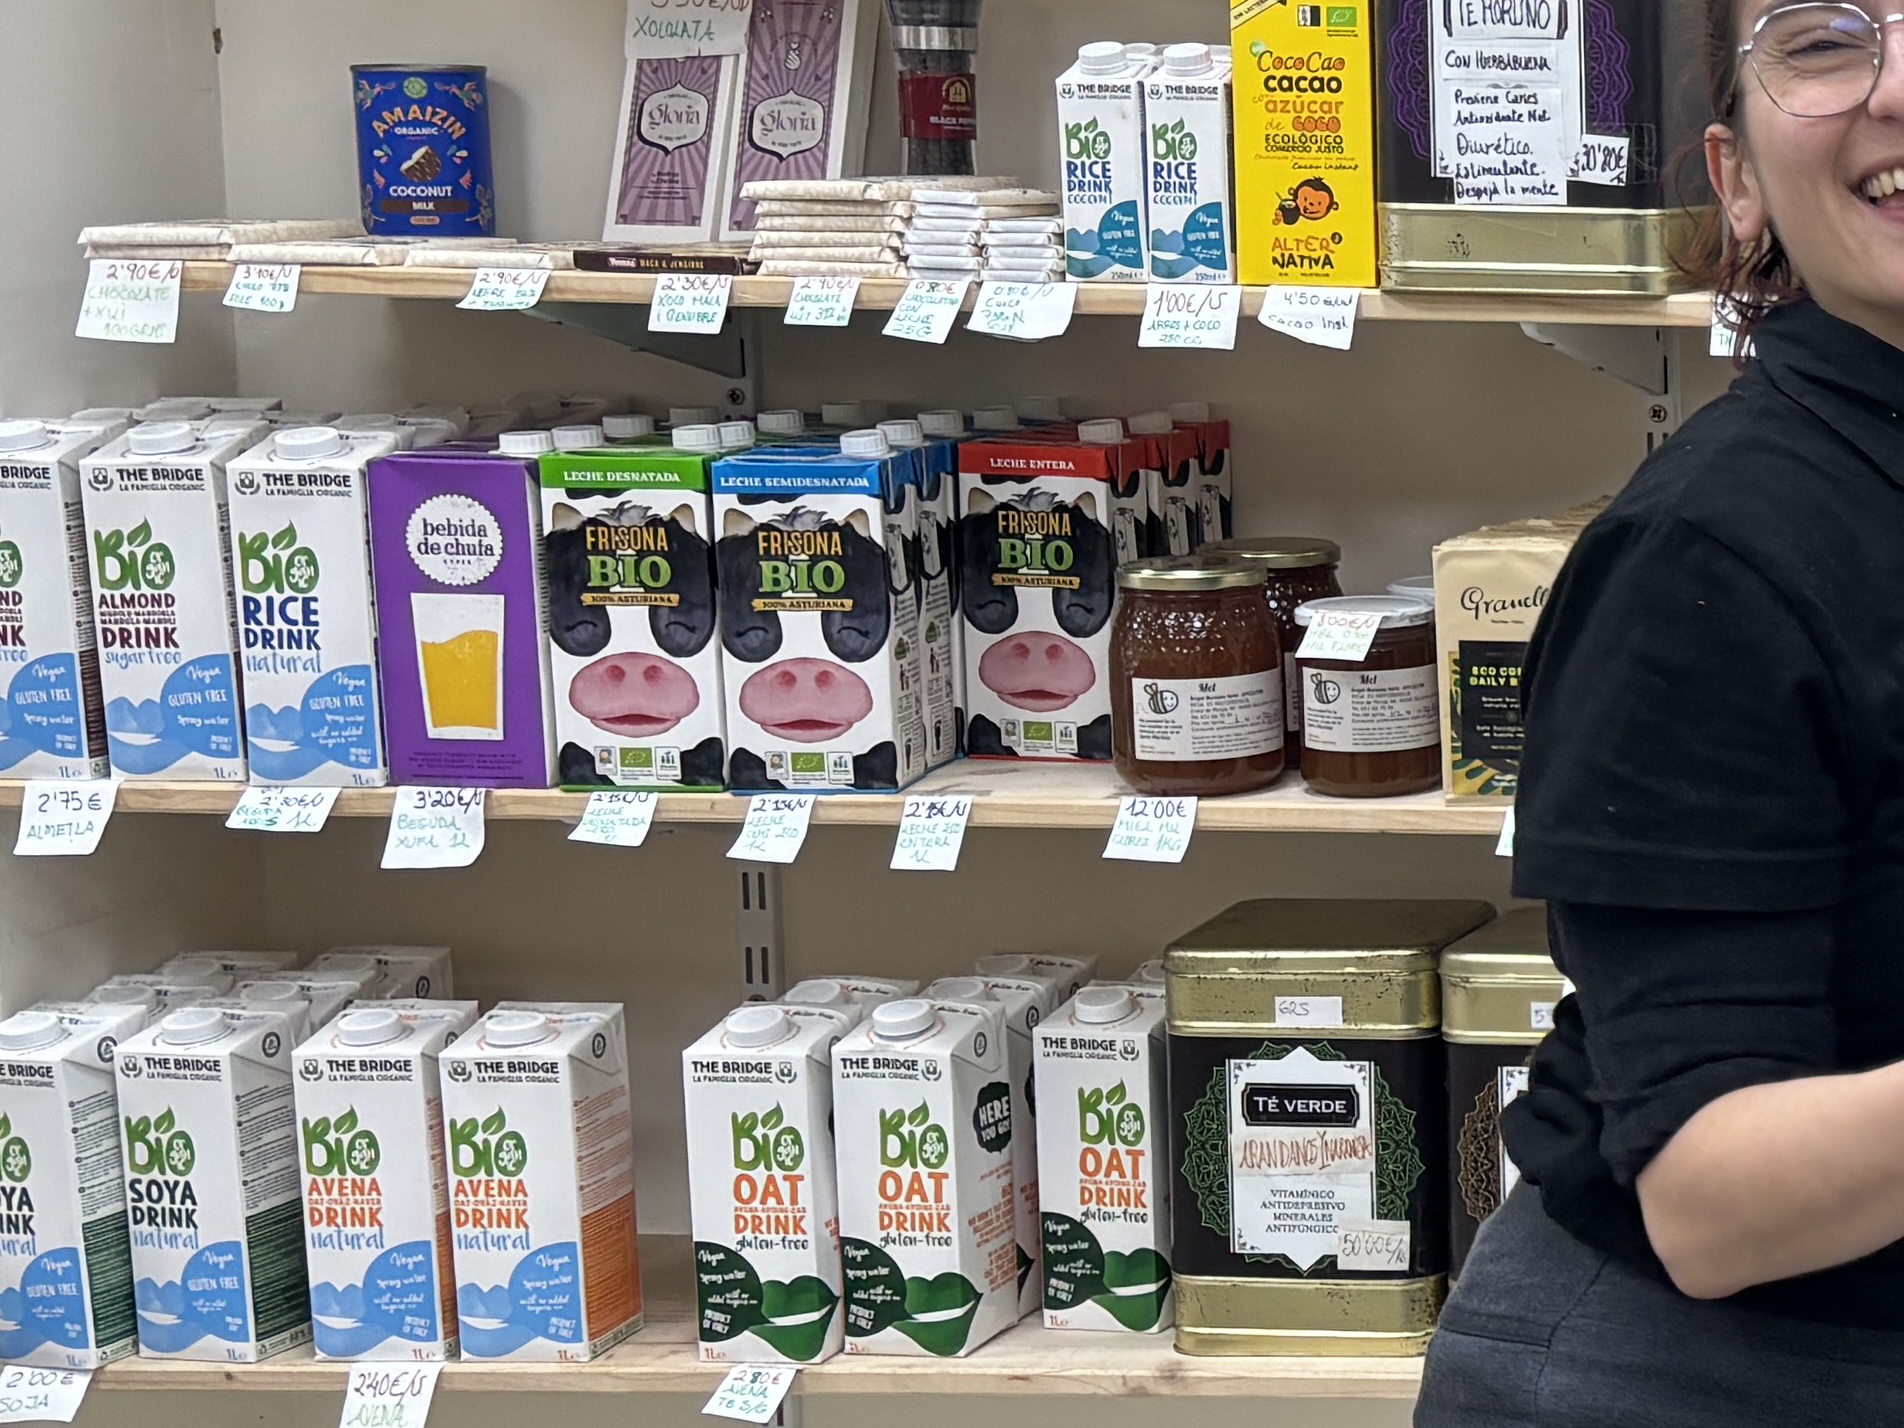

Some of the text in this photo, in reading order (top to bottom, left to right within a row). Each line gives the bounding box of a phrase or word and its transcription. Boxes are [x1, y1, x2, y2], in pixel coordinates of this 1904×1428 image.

[1077, 83, 1131, 95] THE BRIDGE
[1164, 83, 1220, 96] THE BRIDGE
[1263, 75, 1343, 95] cacao
[1264, 95, 1344, 116] azúcar
[370, 104, 467, 141] AMAIZIN
[1264, 133, 1344, 146] ECOLÓGICO
[1066, 161, 1111, 179] RICE
[1153, 161, 1198, 180] RICE
[389, 185, 453, 199] COCONUT
[1067, 179, 1113, 195] DRINK
[1153, 179, 1198, 196] DRINK
[411, 201, 436, 212] MILK
[1271, 236, 1332, 254] ALTER
[1, 465, 51, 481] BRIDGE
[989, 458, 1076, 471] LECHE ENTERA
[116, 468, 205, 483] THE BRIDGE
[262, 473, 352, 490] THE BRIDGE
[563, 471, 681, 483] LECHE DESNATADA
[720, 477, 870, 488] LECHE SEMIDESNATADA
[422, 518, 488, 539] bebida
[997, 510, 1072, 537] FRISONA
[416, 538, 495, 558] de chufa
[586, 525, 669, 552] FRISONA
[758, 531, 843, 557] FRISONA
[999, 538, 1075, 571] BIO
[587, 554, 671, 590] BIO
[759, 560, 845, 595] BIO
[98, 592, 176, 609] ALMOND
[242, 596, 320, 627] RICE
[101, 625, 180, 649] DRINK
[244, 628, 322, 651] DRINK
[246, 647, 322, 674] natural
[1279, 1001, 1309, 1016] 625
[978, 1099, 1011, 1127] HERE
[1253, 1095, 1346, 1114] TÉ VERDE
[1078, 1148, 1146, 1179] OAT
[129, 1179, 198, 1207] SOYA
[307, 1178, 383, 1197] AVENA
[732, 1174, 805, 1205] OAT
[878, 1172, 949, 1204] OAT
[1079, 1187, 1148, 1208] DRINK
[1270, 1189, 1335, 1199] VITAMÍNICO
[132, 1207, 199, 1230] DRINK
[309, 1207, 383, 1228] DRINK
[734, 1211, 808, 1236] DRINK
[878, 1210, 952, 1233] DRINK
[1273, 1212, 1333, 1222] MINERALES
[310, 1226, 385, 1252] natural
